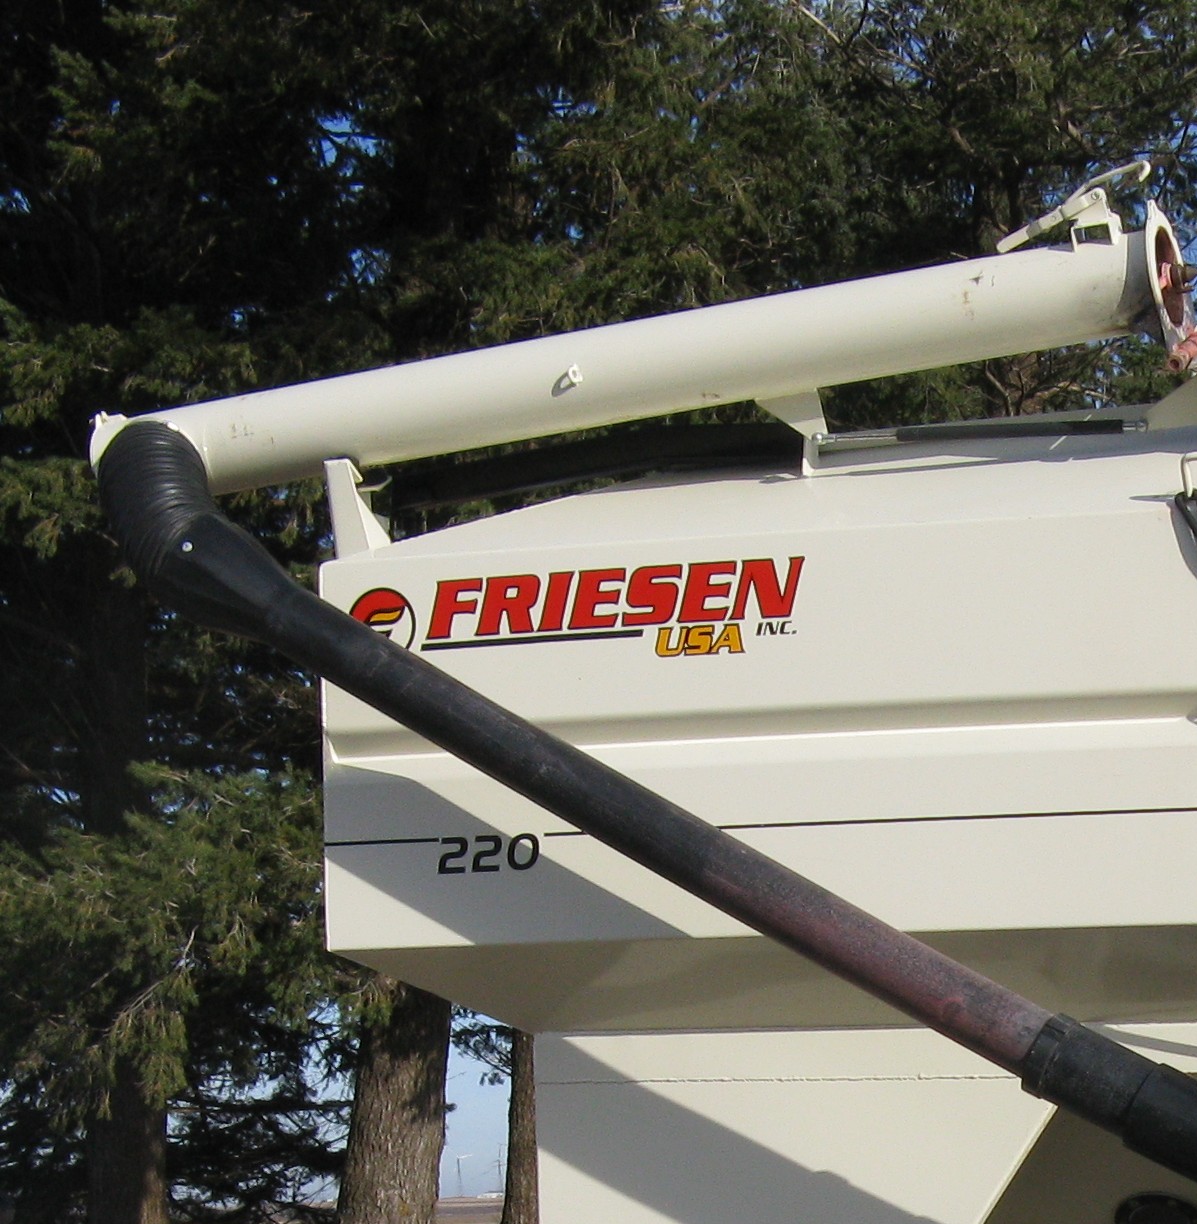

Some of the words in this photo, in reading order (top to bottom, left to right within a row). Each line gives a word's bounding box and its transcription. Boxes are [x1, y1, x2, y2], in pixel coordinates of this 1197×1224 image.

[425, 556, 805, 641] FRIESEN
[653, 623, 746, 658] USA
[755, 619, 798, 637] INC.
[437, 833, 540, 875] 220
